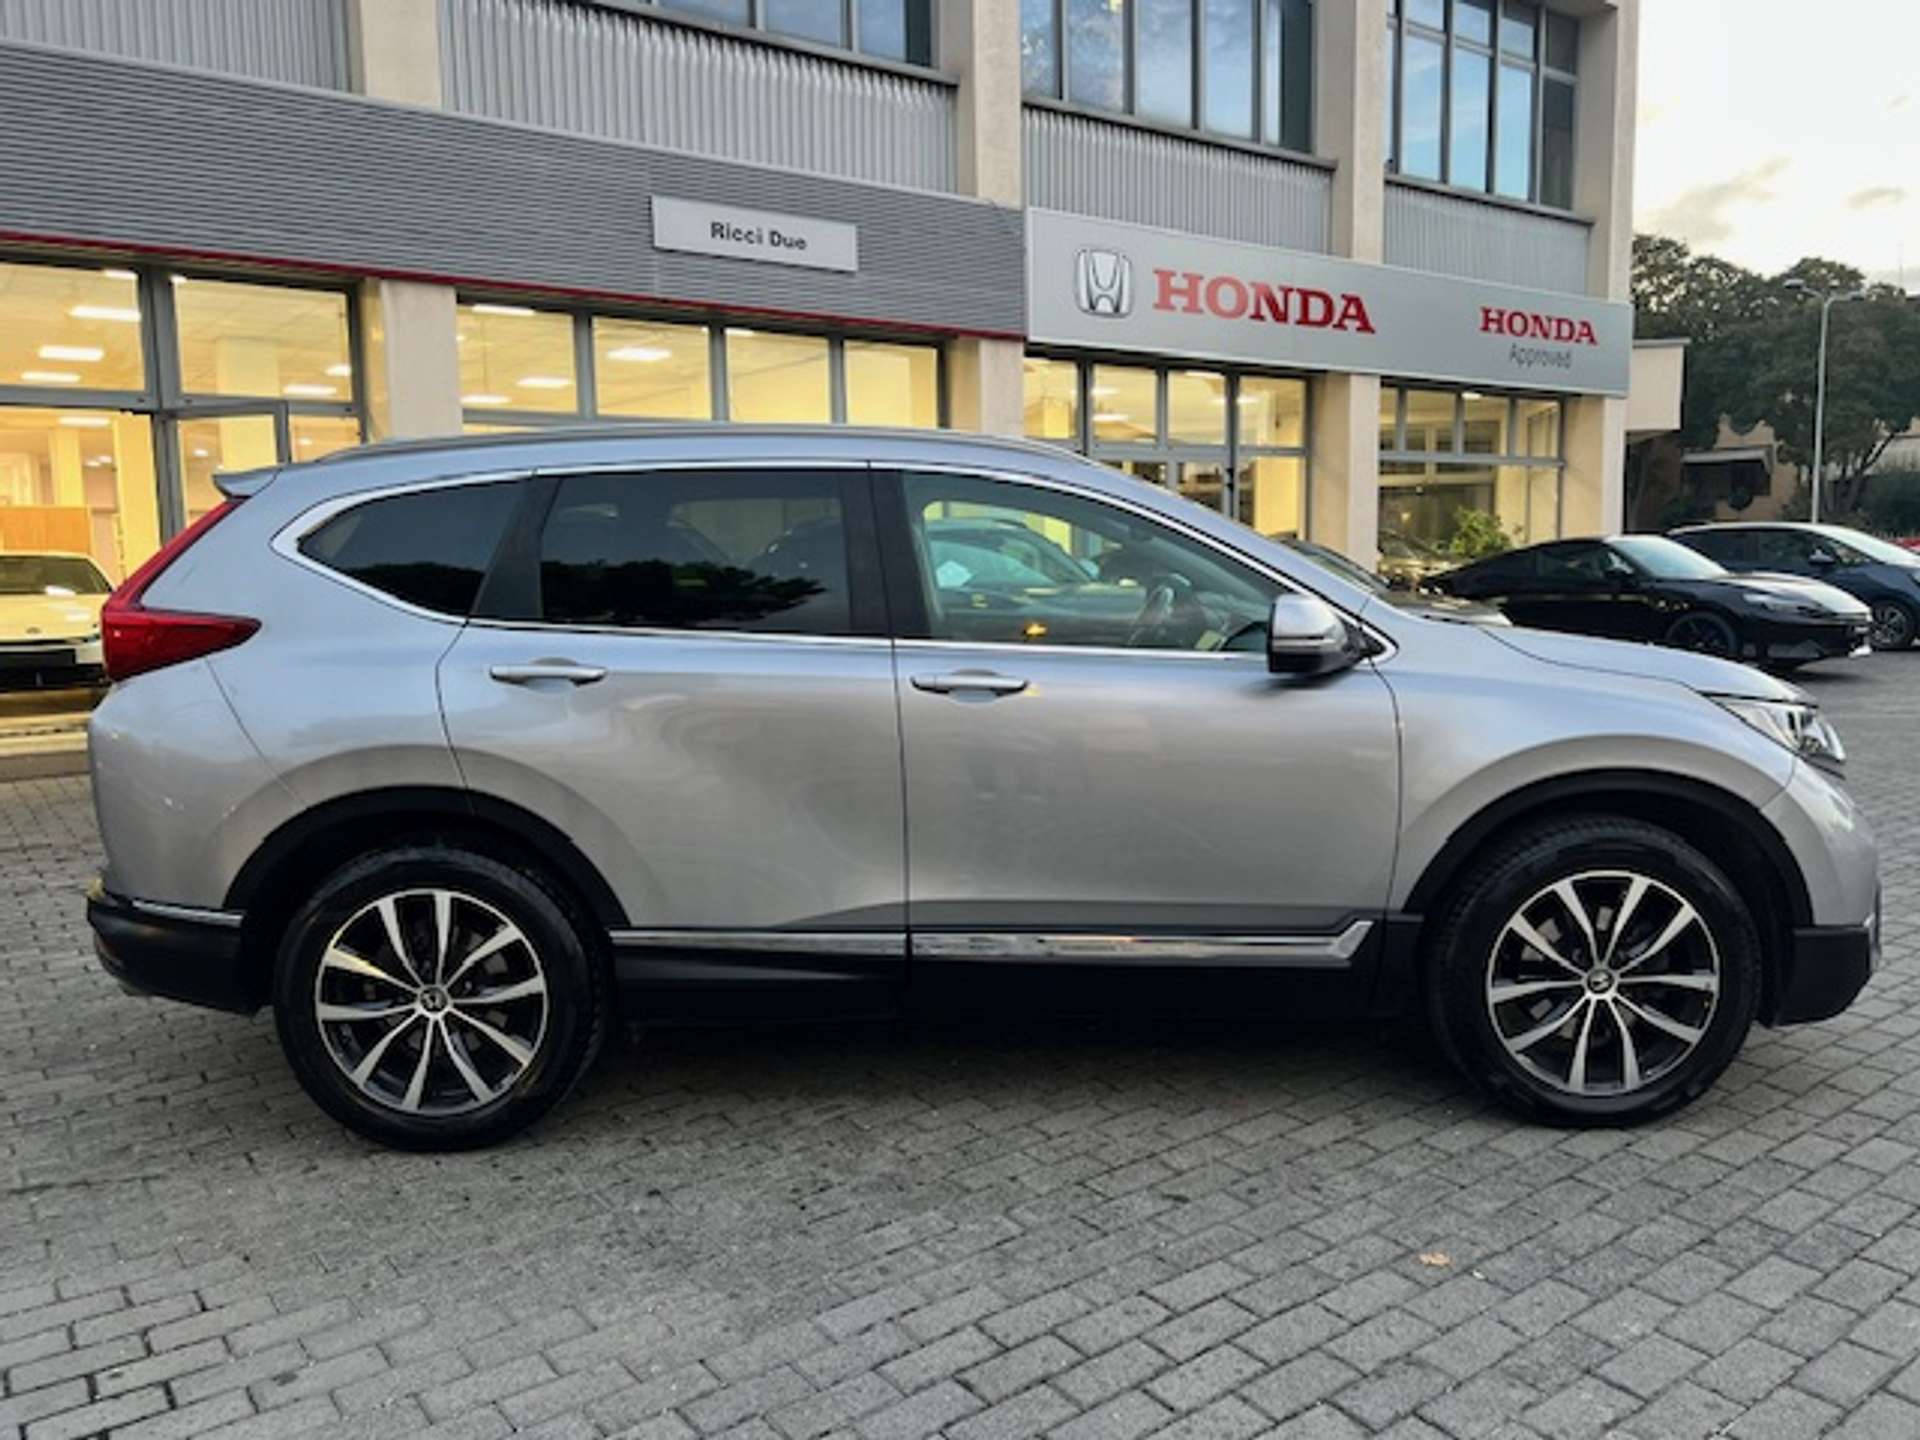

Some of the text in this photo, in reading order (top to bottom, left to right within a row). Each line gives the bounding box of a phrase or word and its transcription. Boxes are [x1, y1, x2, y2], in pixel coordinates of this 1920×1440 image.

[710, 221, 807, 250] Ricci Due
[1153, 268, 1376, 334] HONDA
[1479, 306, 1598, 346] HONDA
[1509, 342, 1572, 369] Approved
